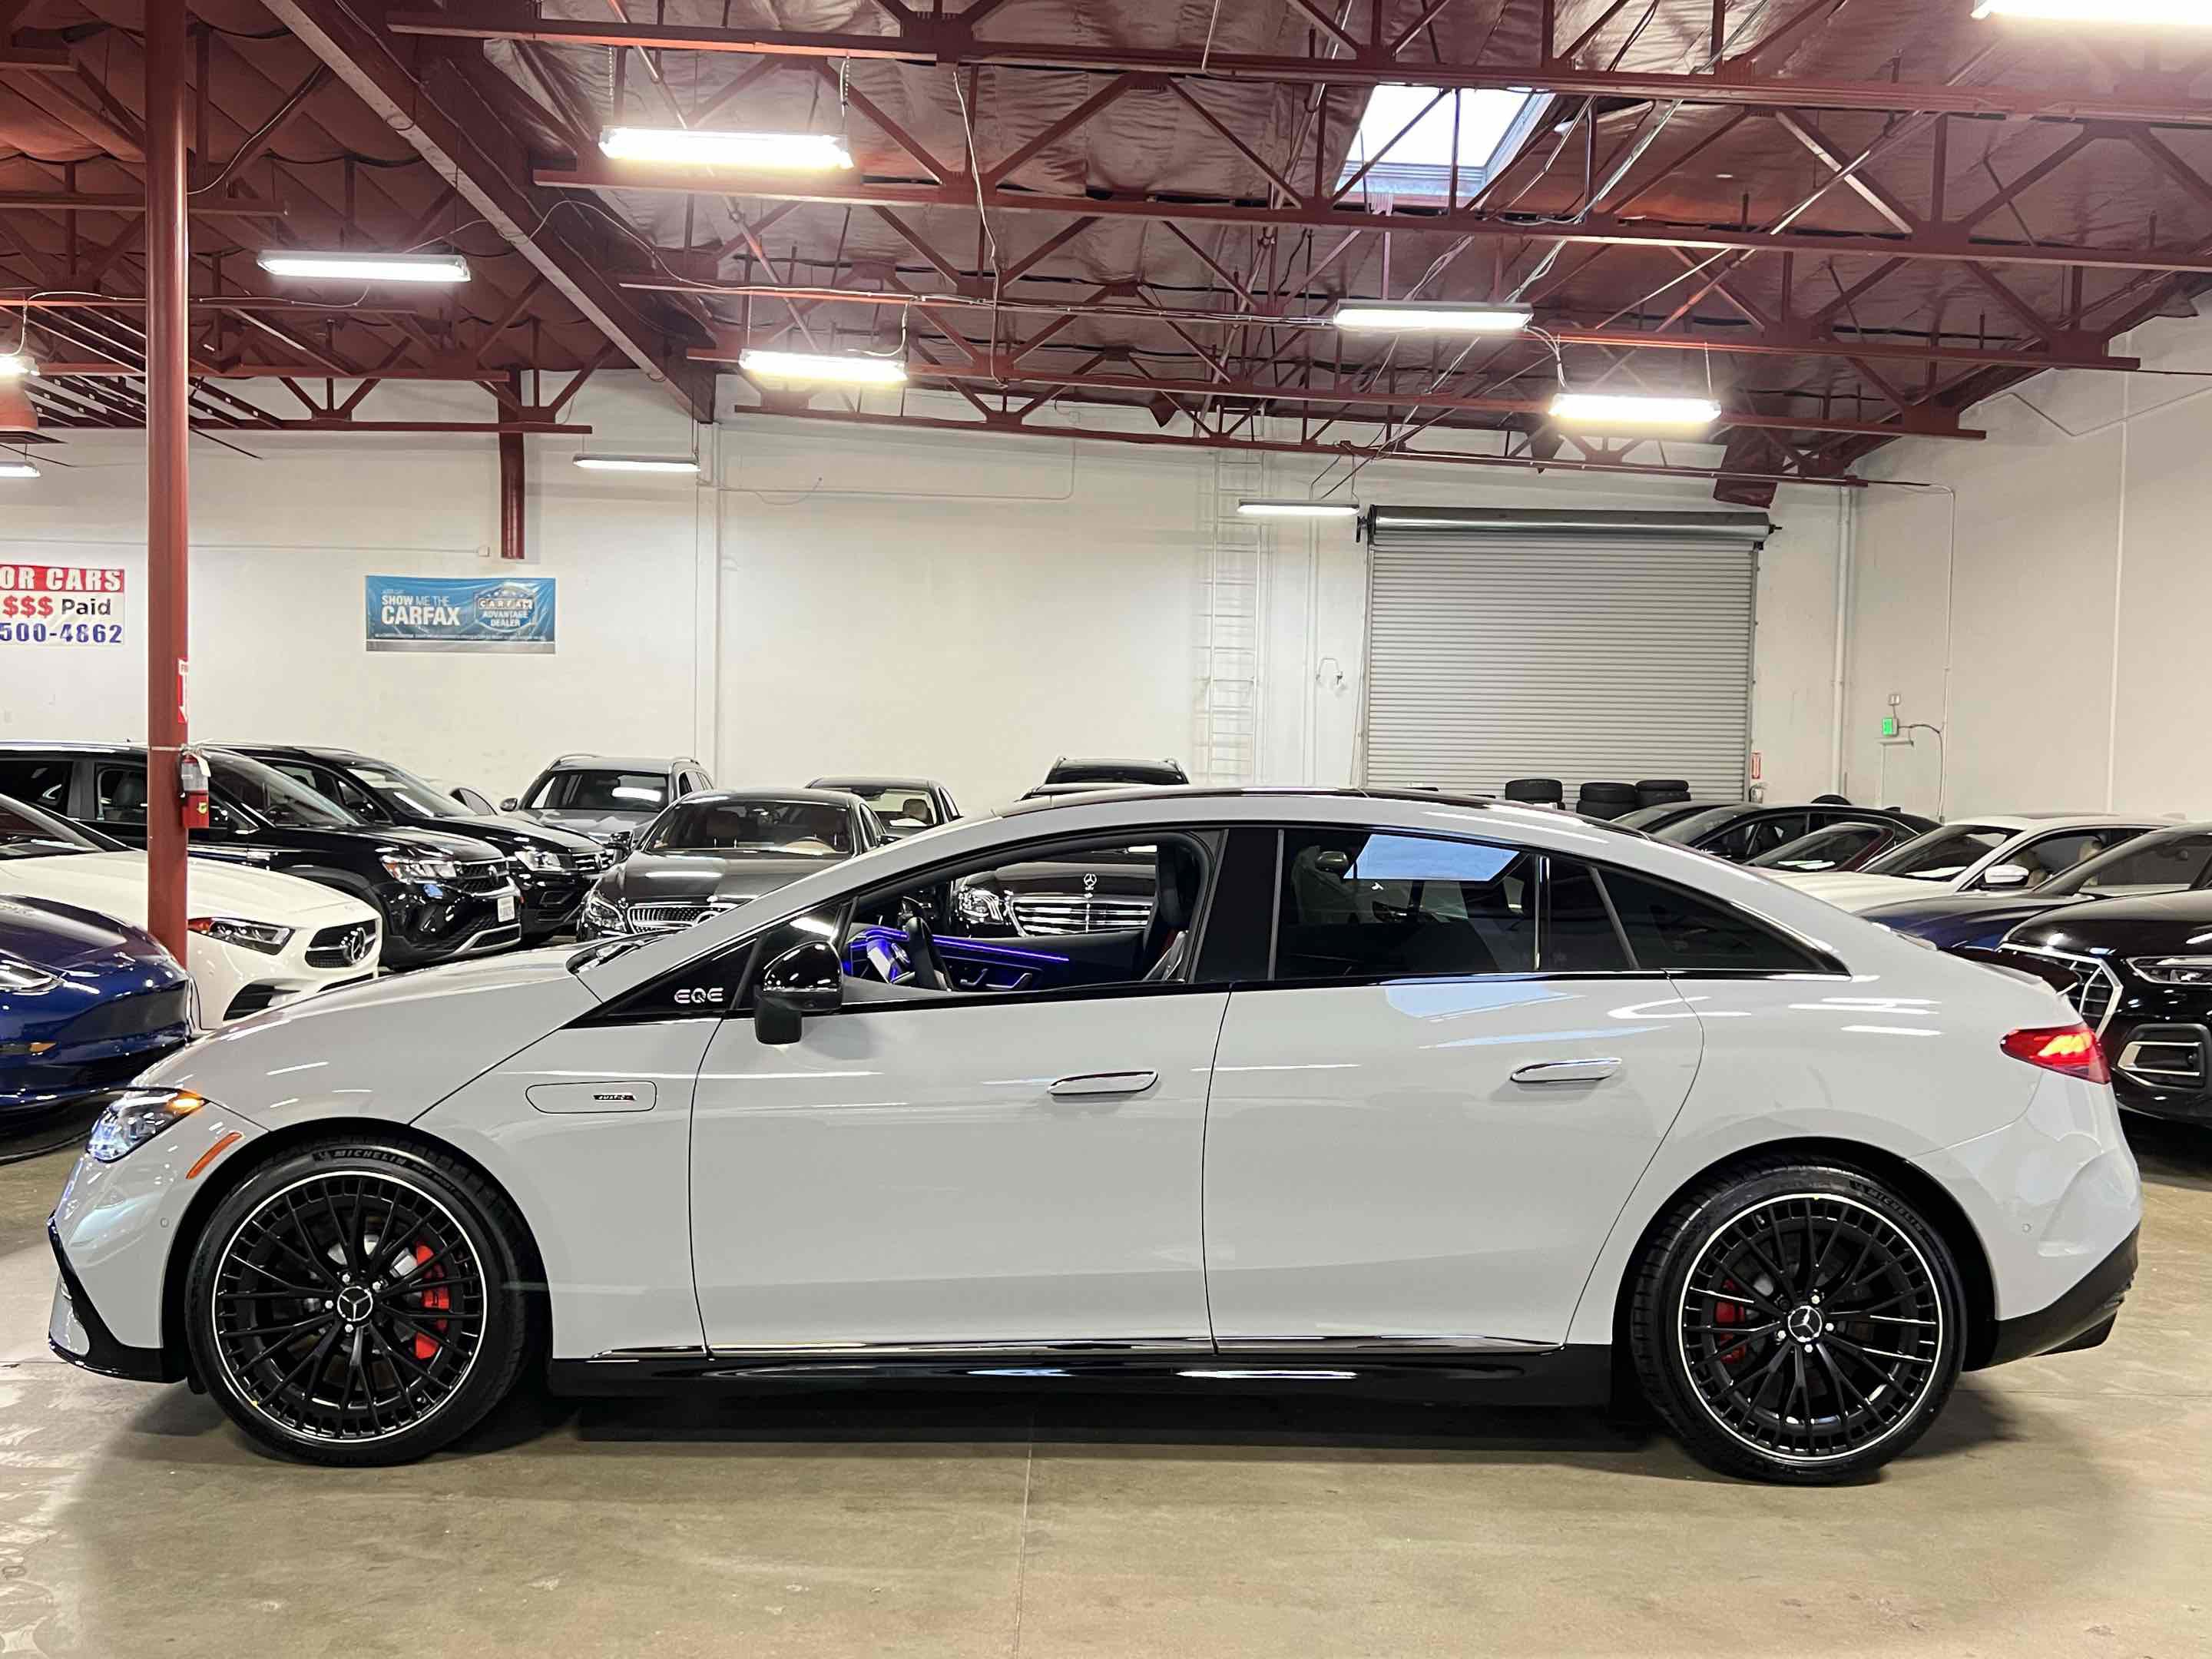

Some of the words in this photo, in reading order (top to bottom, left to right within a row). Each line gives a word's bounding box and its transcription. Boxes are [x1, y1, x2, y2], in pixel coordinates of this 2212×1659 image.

[46, 568, 121, 591] CARS
[2, 595, 54, 618] $$$
[61, 598, 111, 615] Paid
[381, 595, 413, 605] SHOW
[416, 596, 430, 606] ME
[432, 596, 449, 606] THE
[381, 606, 460, 626] CARFAX
[490, 619, 521, 628] DEALER
[0, 623, 122, 644] 500-4862
[674, 988, 724, 1004] EQE
[334, 1150, 407, 1165] MICHELIN
